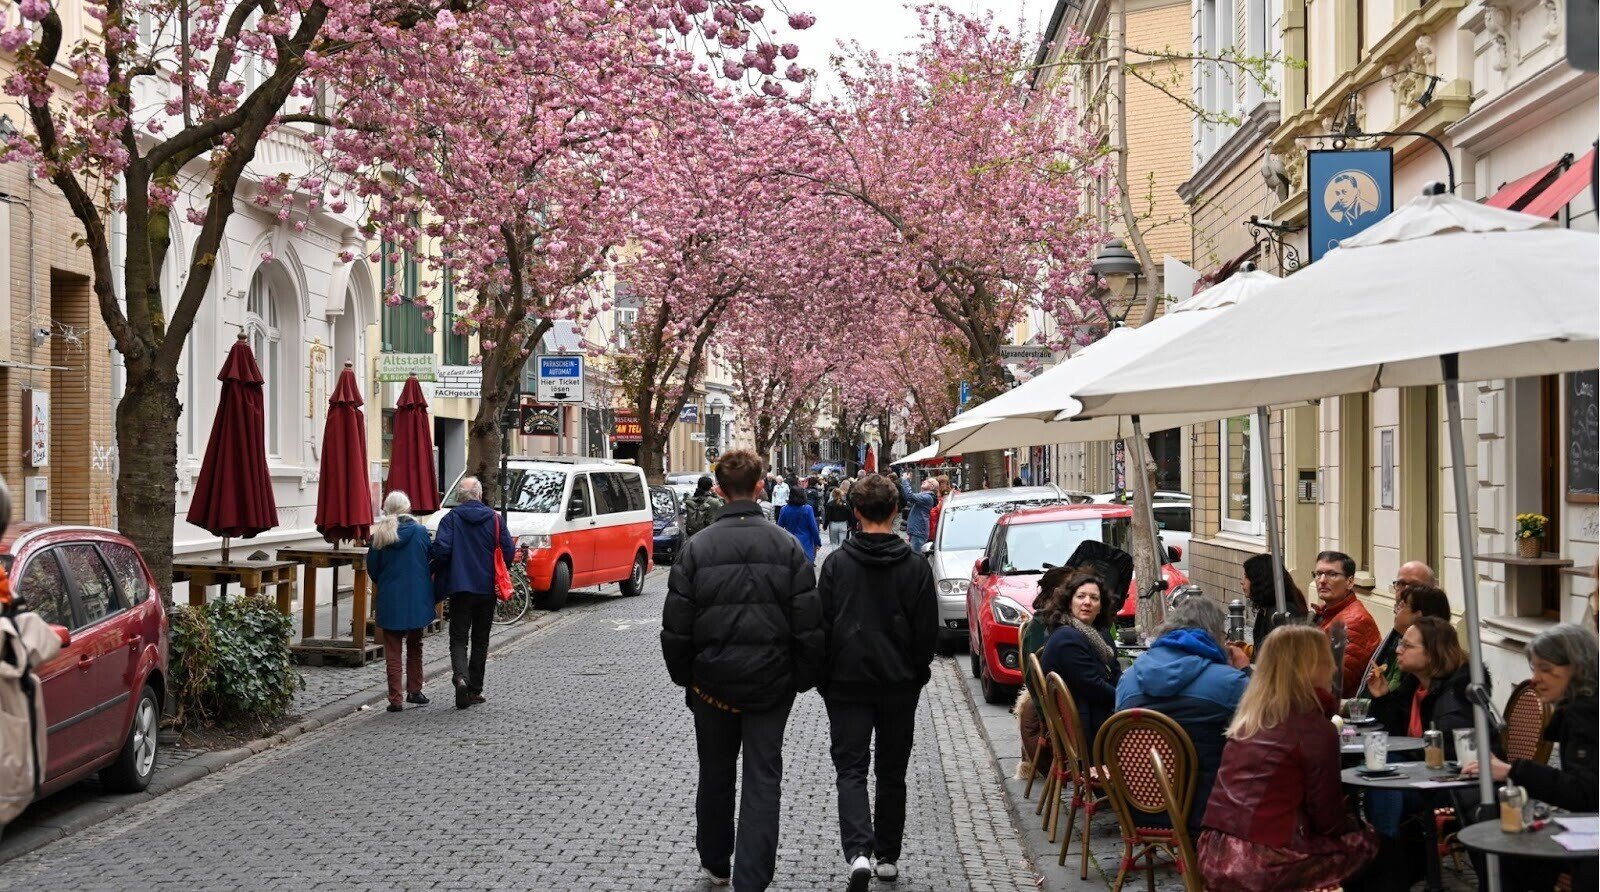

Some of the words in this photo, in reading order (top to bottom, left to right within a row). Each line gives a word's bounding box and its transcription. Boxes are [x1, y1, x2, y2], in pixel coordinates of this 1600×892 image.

[384, 356, 432, 365] Altstadt
[542, 360, 578, 368] PARKSCHEIN-
[548, 368, 572, 376] AUTOMAT
